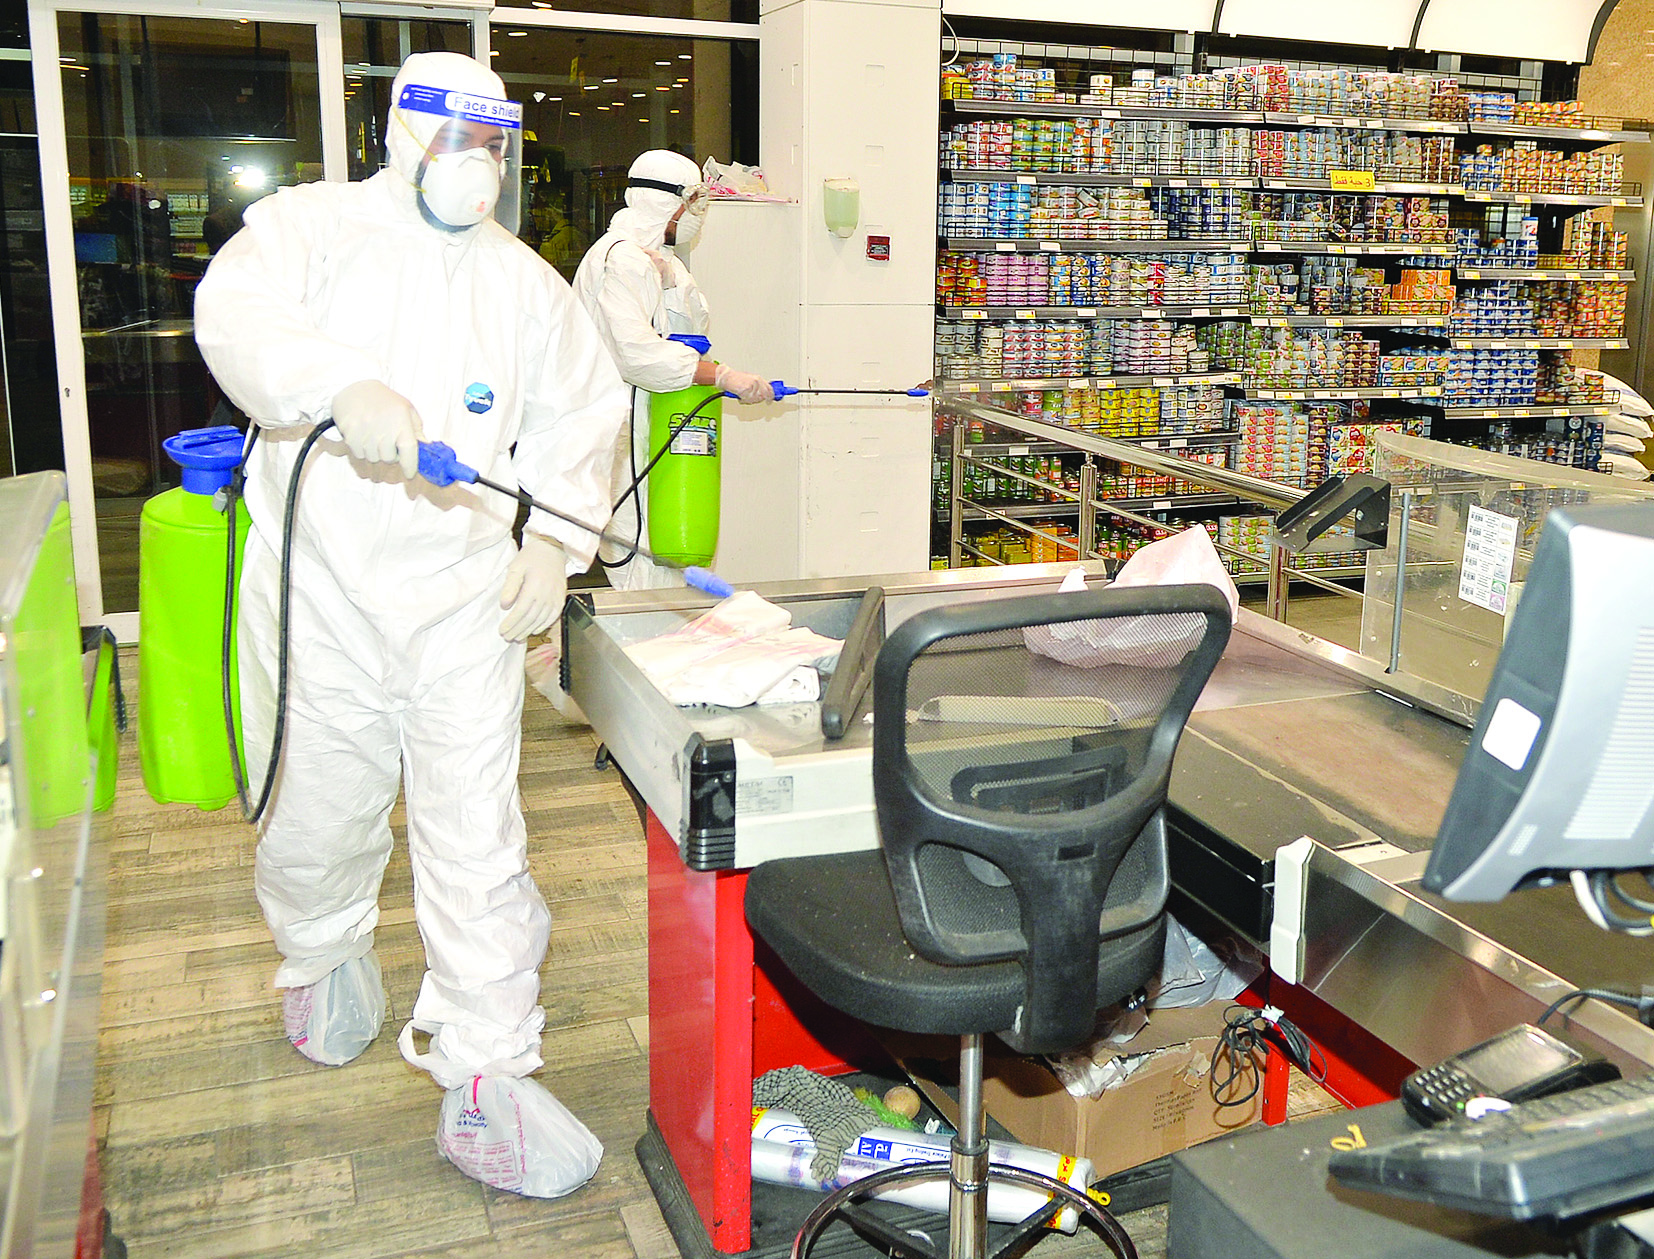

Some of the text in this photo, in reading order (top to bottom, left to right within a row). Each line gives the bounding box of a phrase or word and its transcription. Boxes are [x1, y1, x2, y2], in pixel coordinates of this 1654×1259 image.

[454, 96, 520, 118] Face shield
[1334, 175, 1371, 188] 3 حبة فقط
